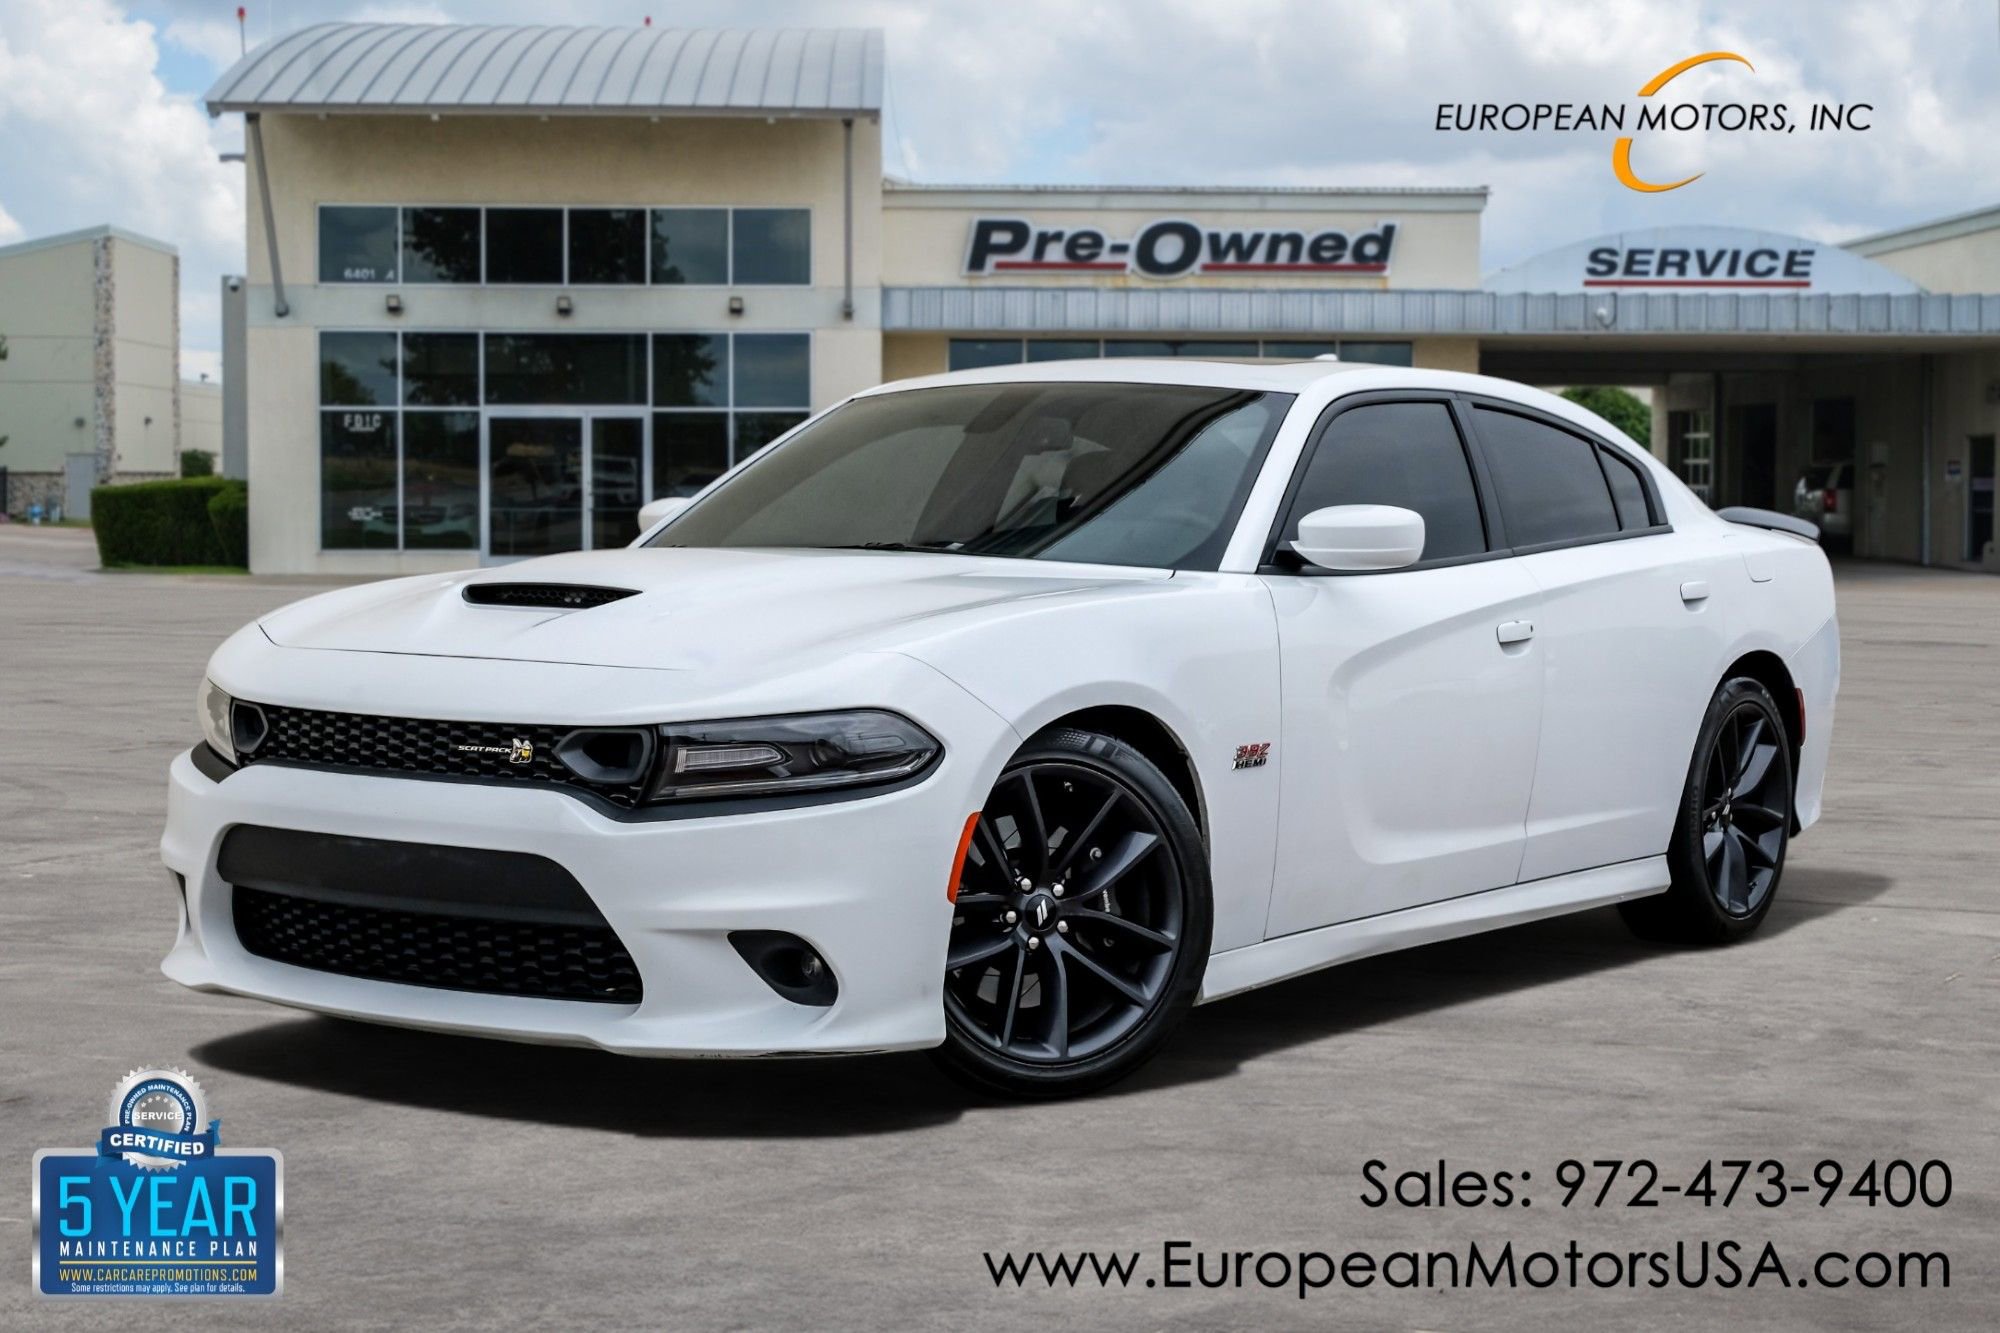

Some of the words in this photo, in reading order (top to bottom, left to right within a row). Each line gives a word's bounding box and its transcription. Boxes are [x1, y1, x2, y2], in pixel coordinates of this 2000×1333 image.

[967, 220, 1397, 275] Pre-Owned
[1585, 247, 1816, 278] SERVICE
[485, 746, 512, 754] PACK
[1232, 758, 1267, 770] HEMI
